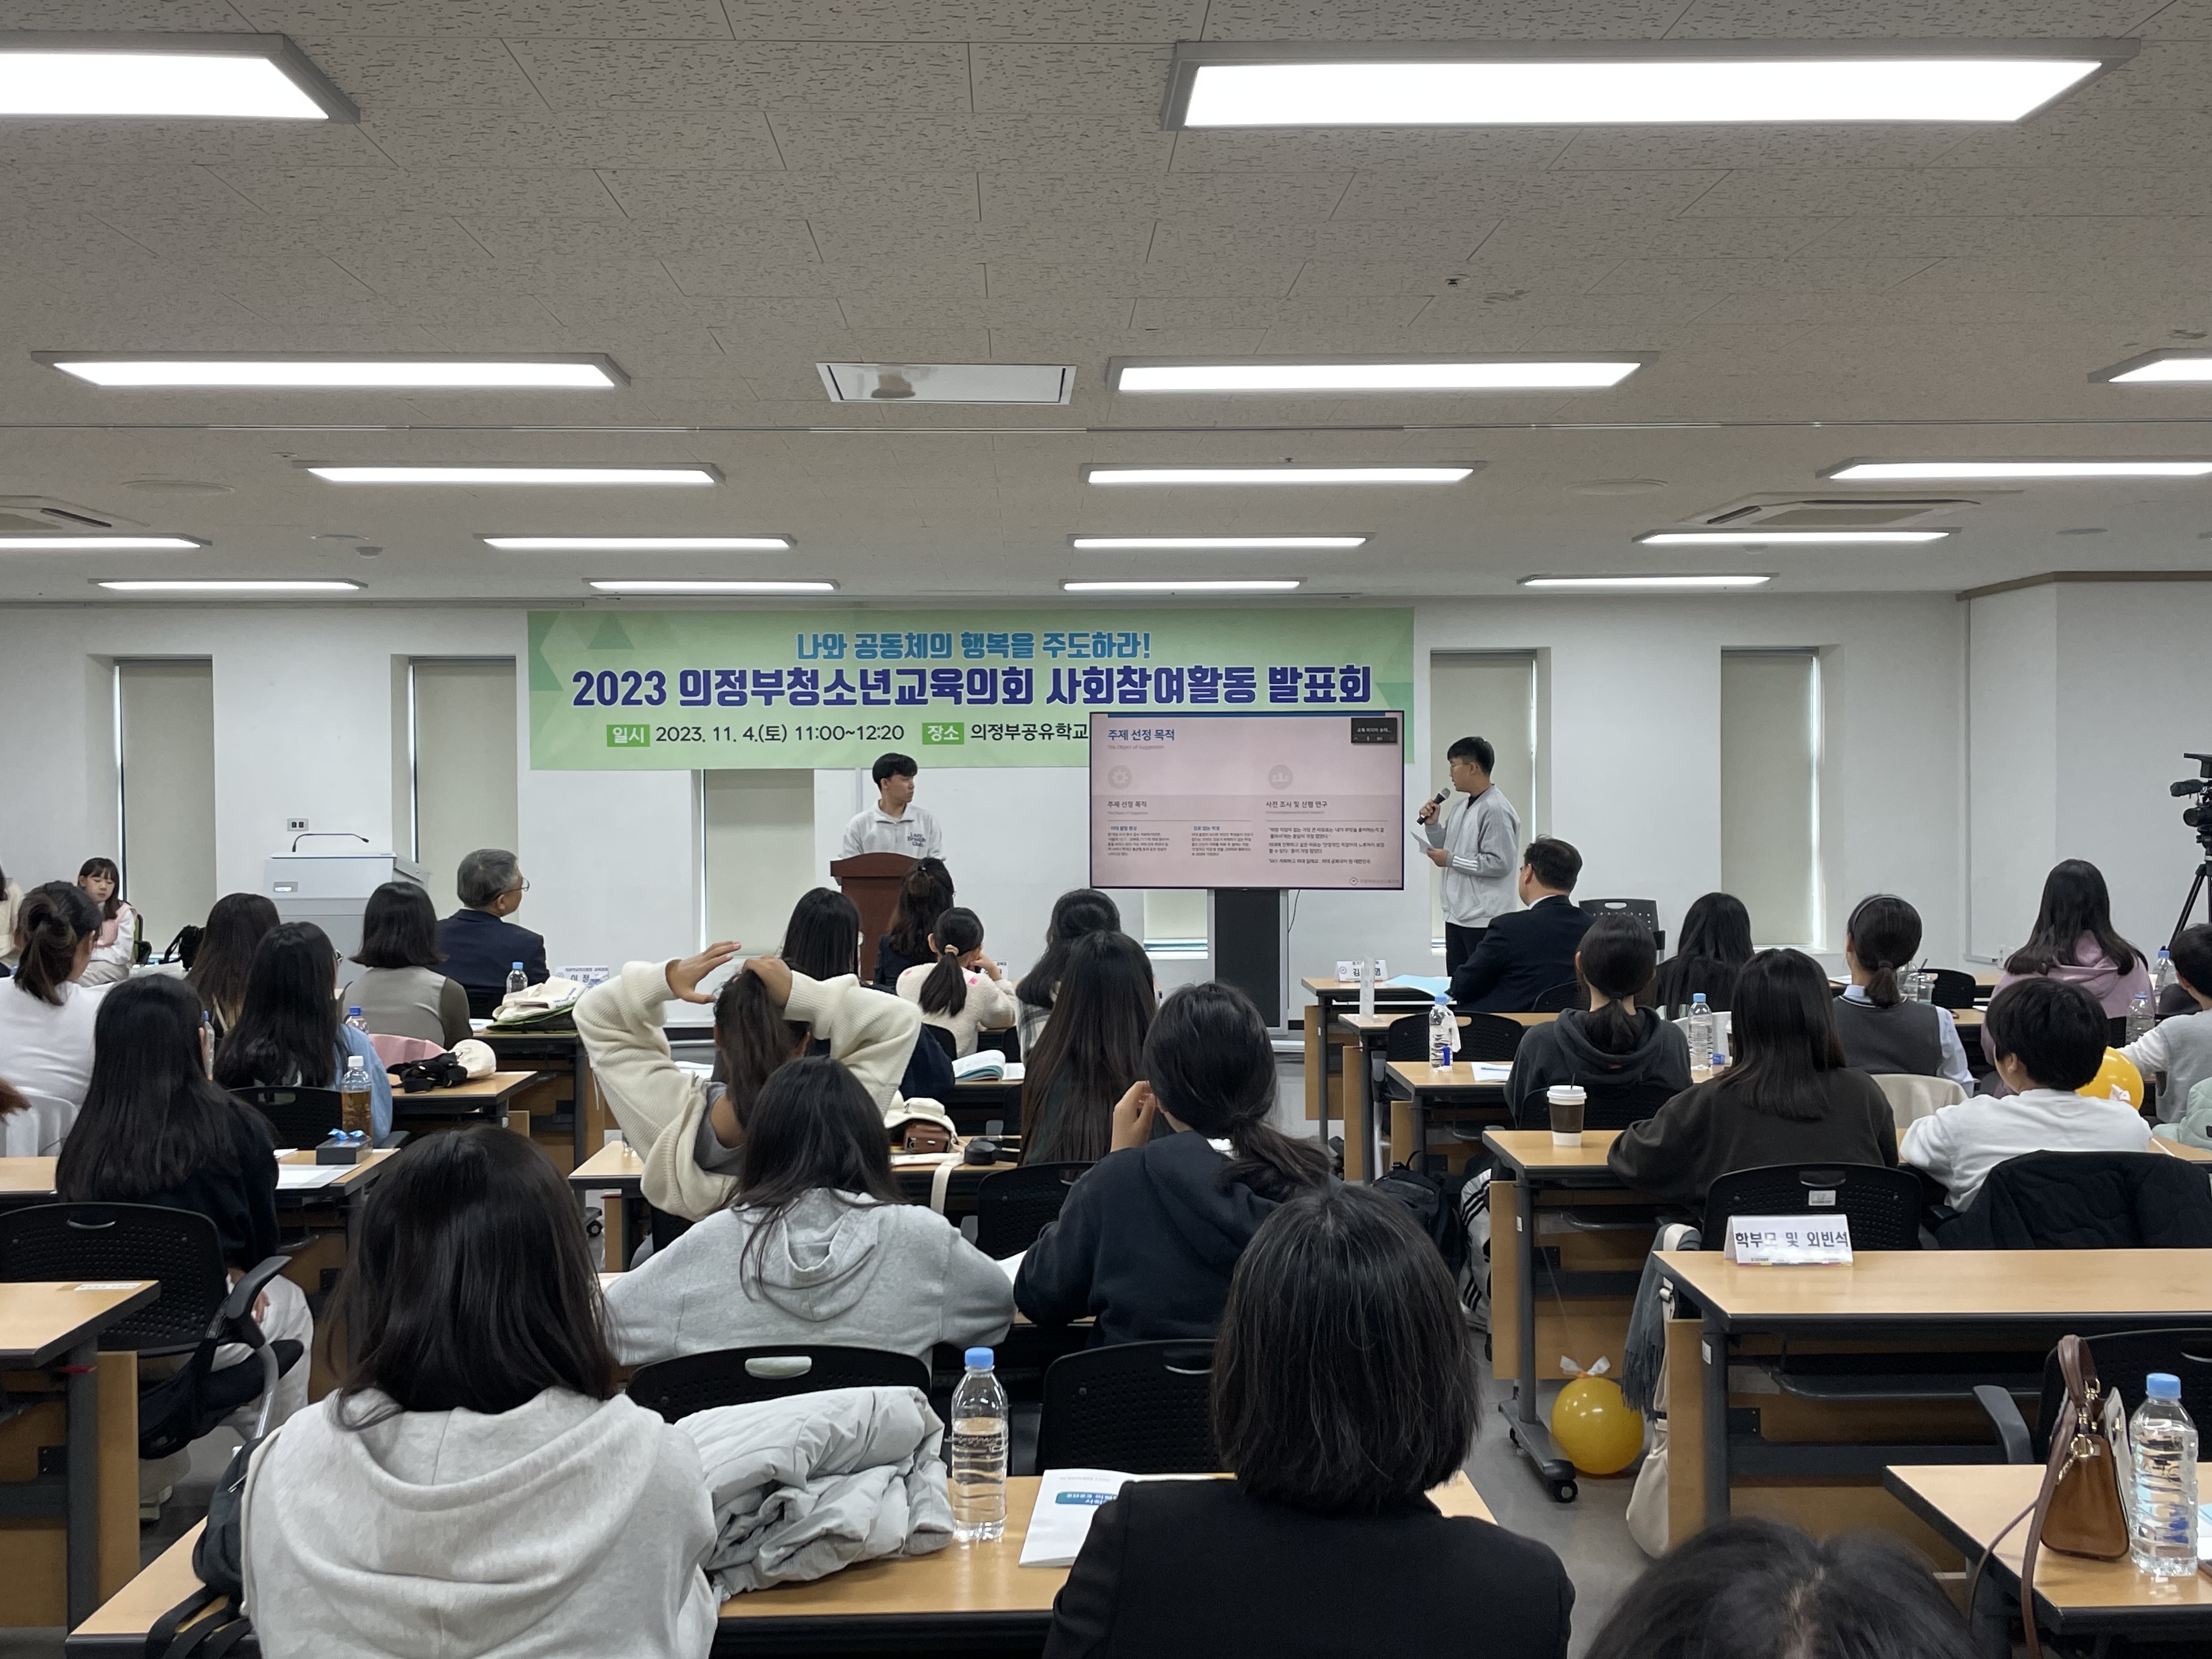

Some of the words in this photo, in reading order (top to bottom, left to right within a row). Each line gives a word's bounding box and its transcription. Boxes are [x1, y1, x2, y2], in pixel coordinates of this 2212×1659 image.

[797, 633, 847, 659] 나와
[854, 633, 952, 659] 공동체의
[961, 631, 1035, 658] 행복을
[1042, 631, 1150, 659] 주도하라!
[573, 669, 667, 706] 2023
[679, 666, 1034, 706] 의정부청소년교육의회
[1046, 665, 1256, 704] 사회참여활동
[1268, 664, 1370, 704] 발표회
[612, 727, 645, 744] 일시
[656, 726, 706, 742] 2023.
[713, 726, 737, 742] 11.
[743, 724, 788, 743] 4.(토)
[795, 725, 904, 741] 11:00~12:20
[928, 725, 960, 742] 장소
[970, 723, 1089, 741] 의정부공유학교
[1108, 729, 1128, 741] 주제
[1131, 729, 1152, 741] 선정
[1154, 729, 1175, 741] 목적
[1735, 1232, 1778, 1248] 학부모
[1786, 1232, 1799, 1248] 및
[1807, 1231, 1849, 1248] 외빈석
